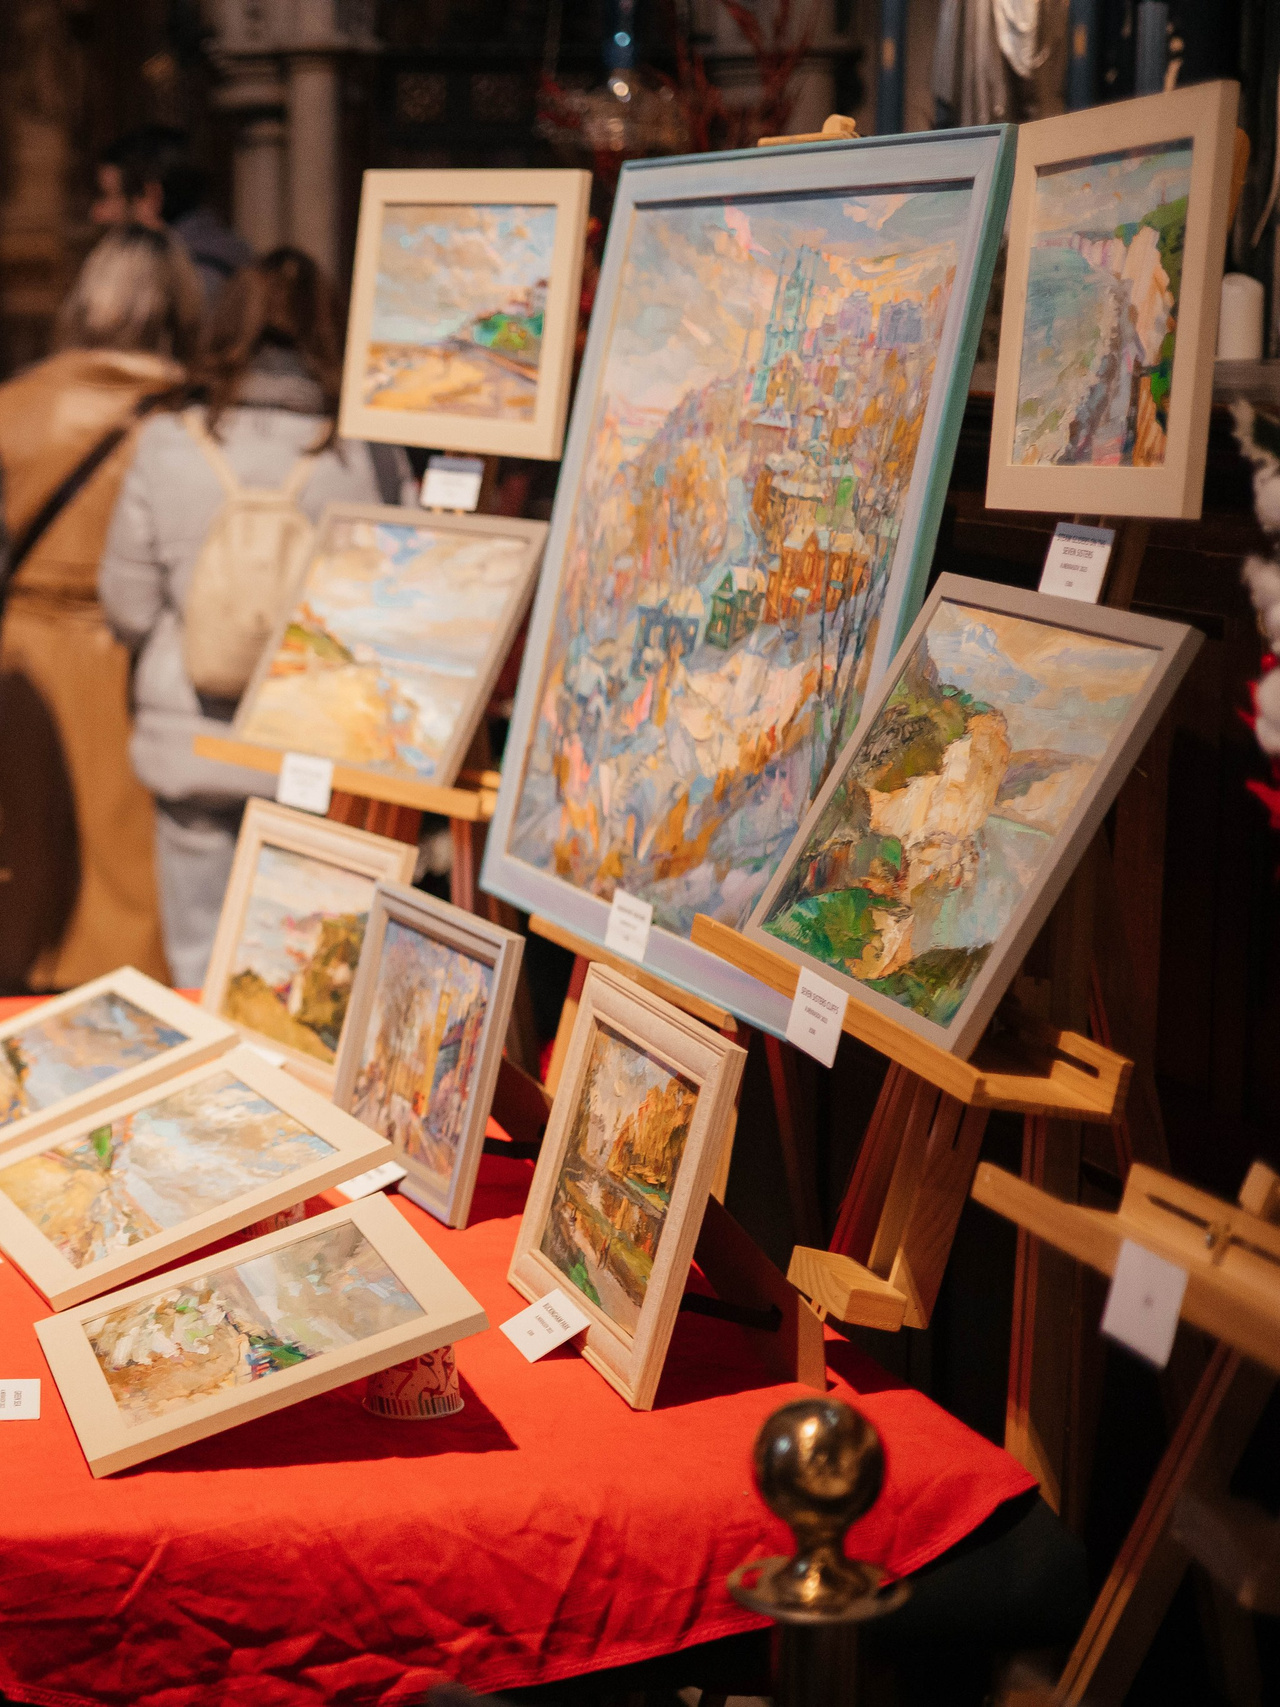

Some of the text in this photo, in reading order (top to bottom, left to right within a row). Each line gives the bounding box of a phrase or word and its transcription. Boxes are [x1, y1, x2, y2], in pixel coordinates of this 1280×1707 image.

[1062, 546, 1093, 559] SEVEN SISTERS
[801, 986, 813, 998] SEVEN
[812, 993, 827, 1007] SISTERS
